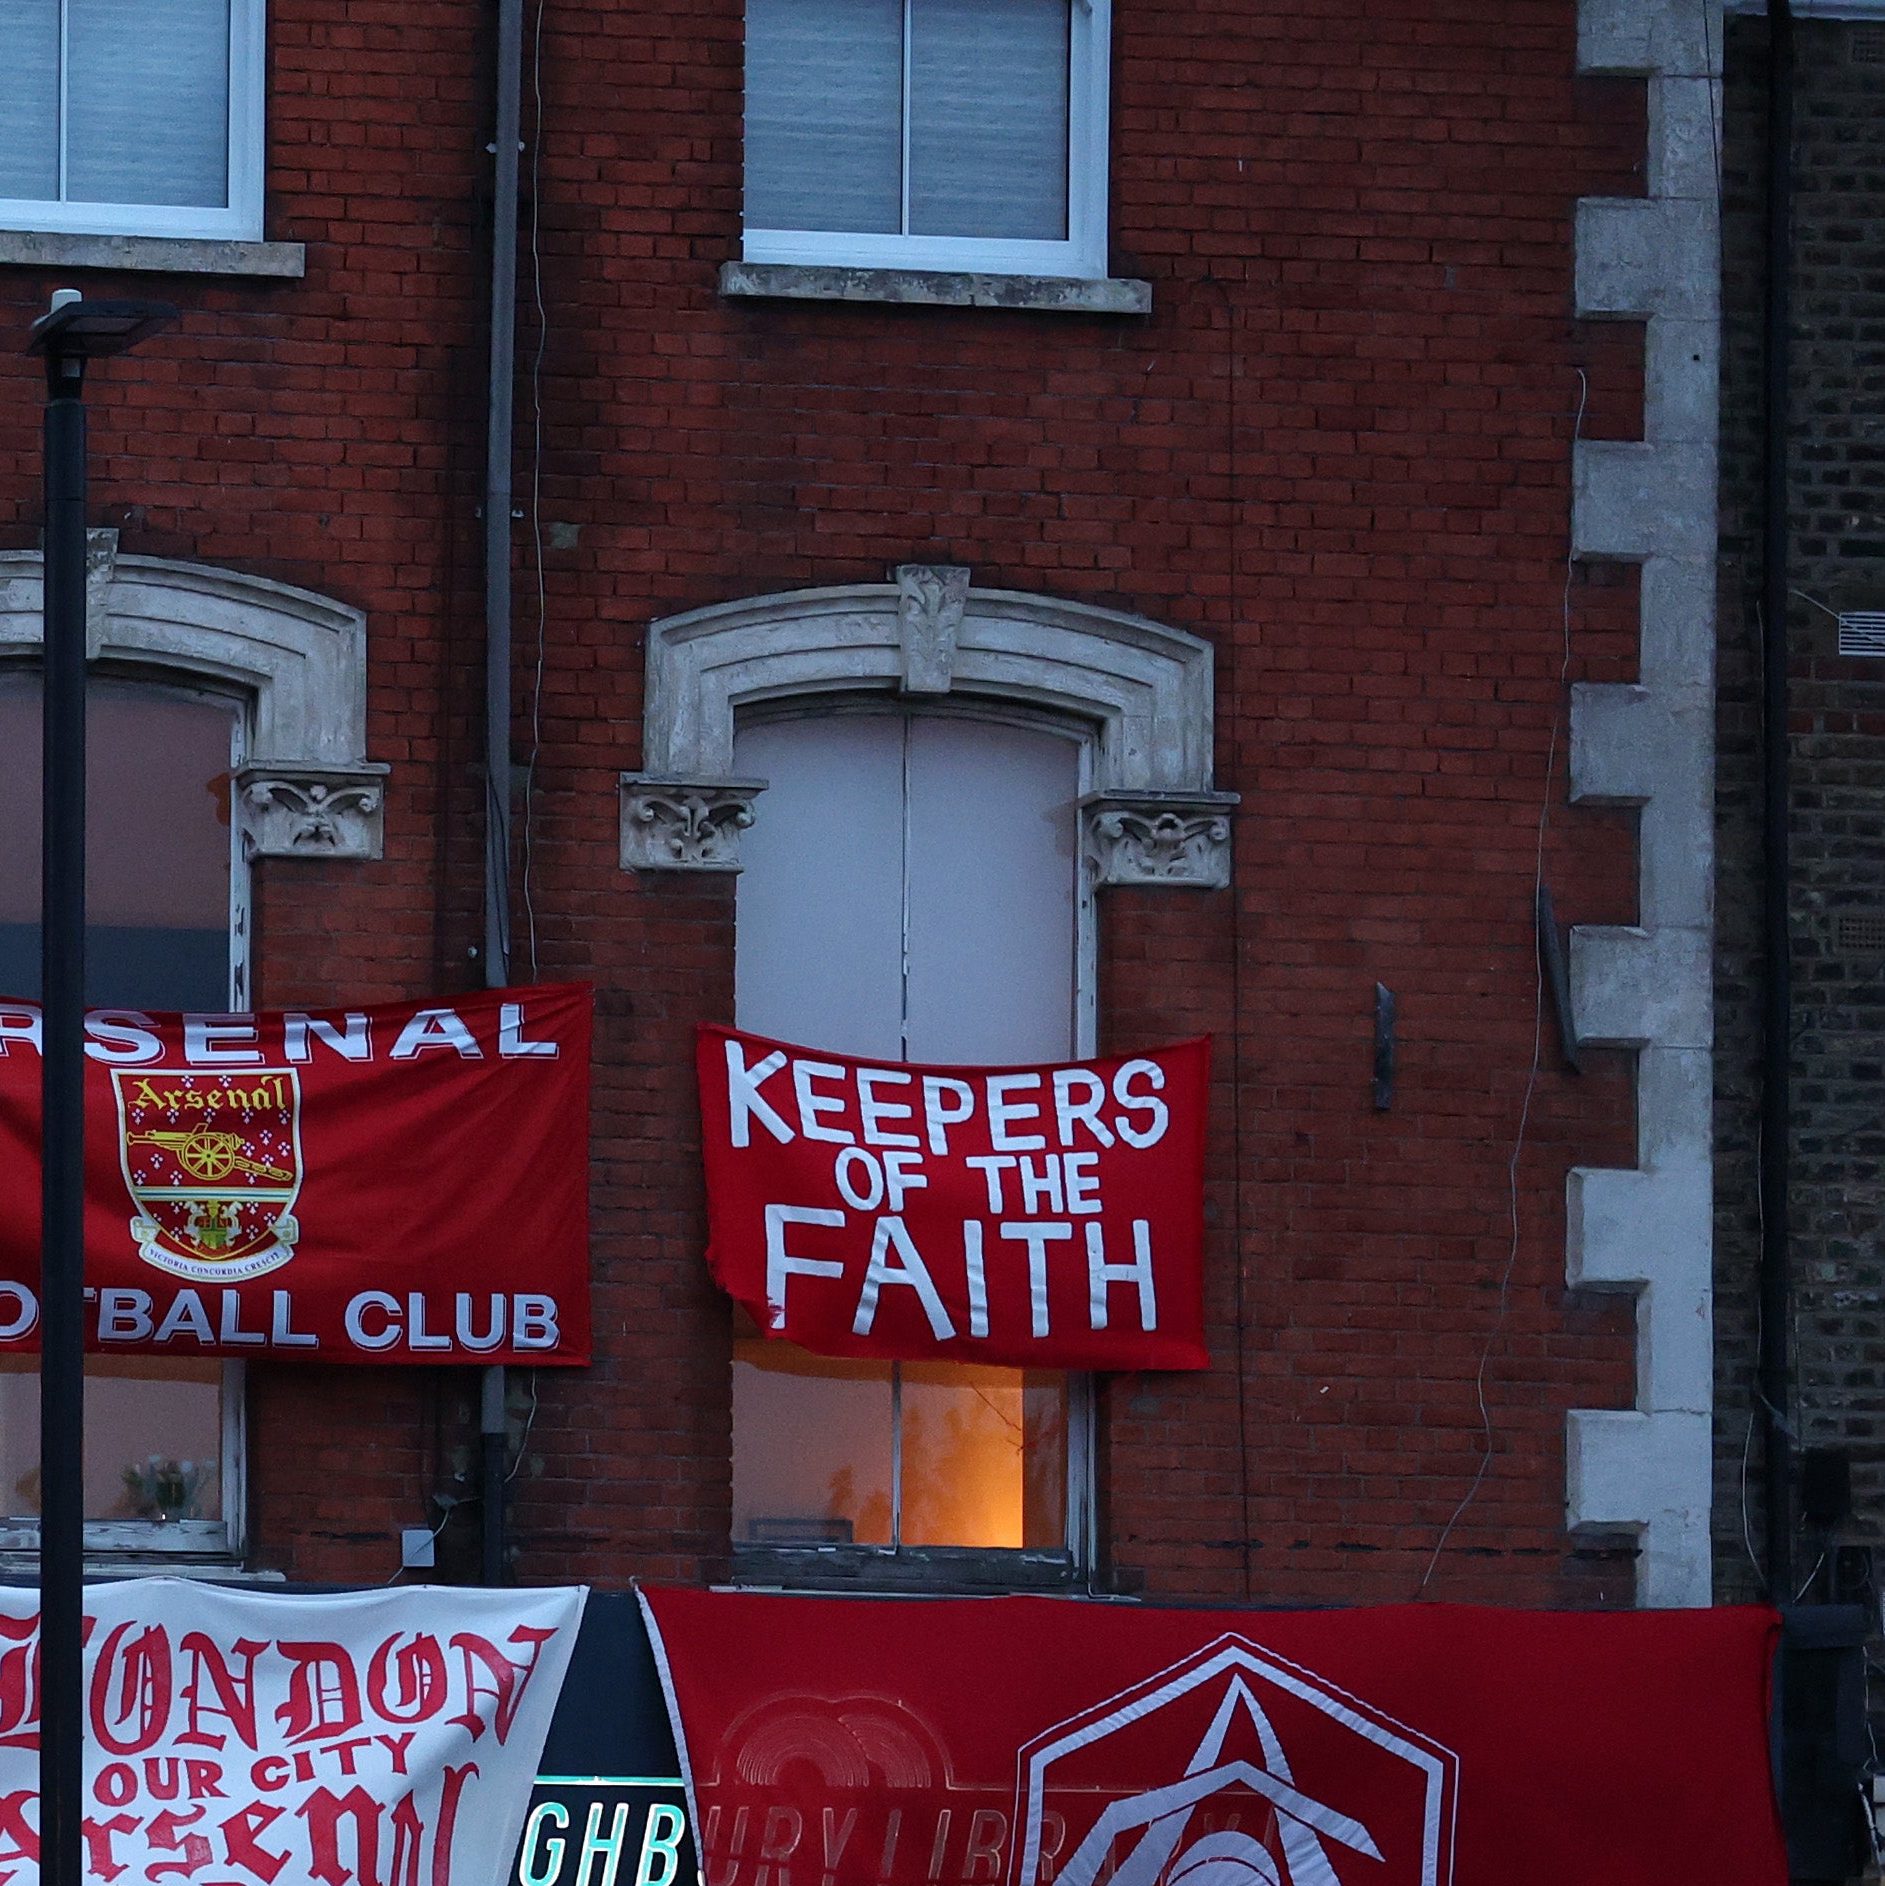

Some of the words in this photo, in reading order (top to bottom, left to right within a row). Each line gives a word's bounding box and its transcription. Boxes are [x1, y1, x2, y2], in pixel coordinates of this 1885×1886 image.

[128, 1076, 283, 1110] Arsenal
[724, 1039, 1169, 1156] KEEPERS
[834, 1146, 927, 1212] OF
[965, 1151, 1103, 1215] THE
[149, 1249, 188, 1272] VICTORIA
[191, 1265, 243, 1276] CONCORDIA
[244, 1252, 281, 1272] CRESCIT
[764, 1204, 1157, 1341] FAITH
[344, 1290, 560, 1354] CLUB
[92, 1756, 230, 1807] OUR
[249, 1732, 416, 1792] CITY
